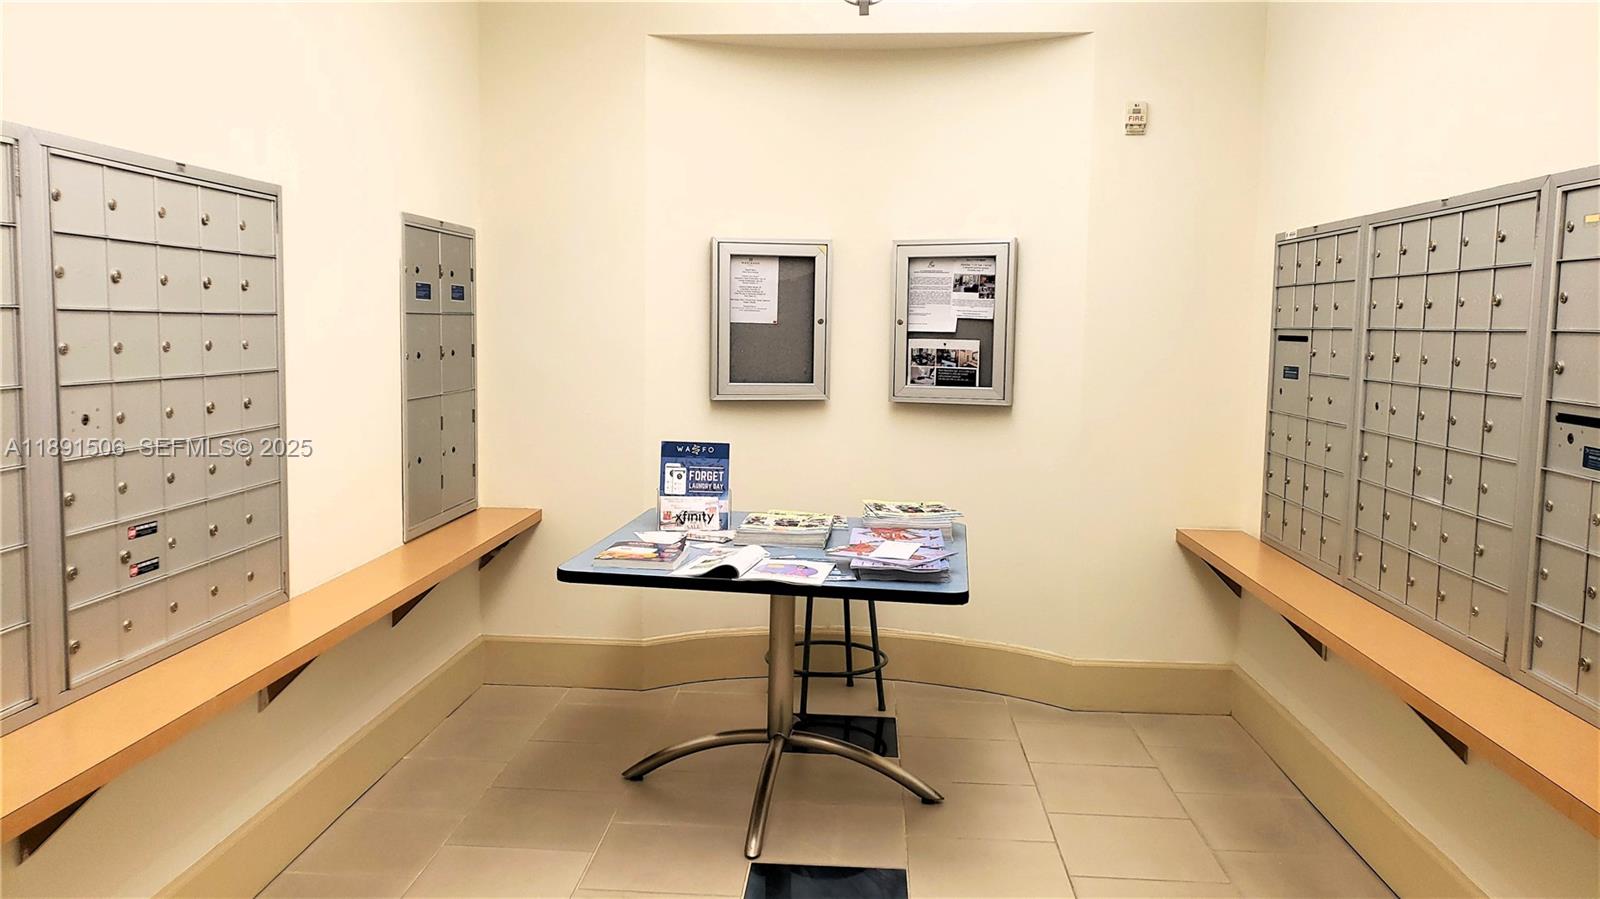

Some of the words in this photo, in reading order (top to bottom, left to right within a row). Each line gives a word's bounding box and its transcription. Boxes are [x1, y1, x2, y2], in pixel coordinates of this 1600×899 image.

[689, 470, 724, 482] FORGET
[713, 483, 724, 491] DAY
[676, 511, 714, 524] xfinity
